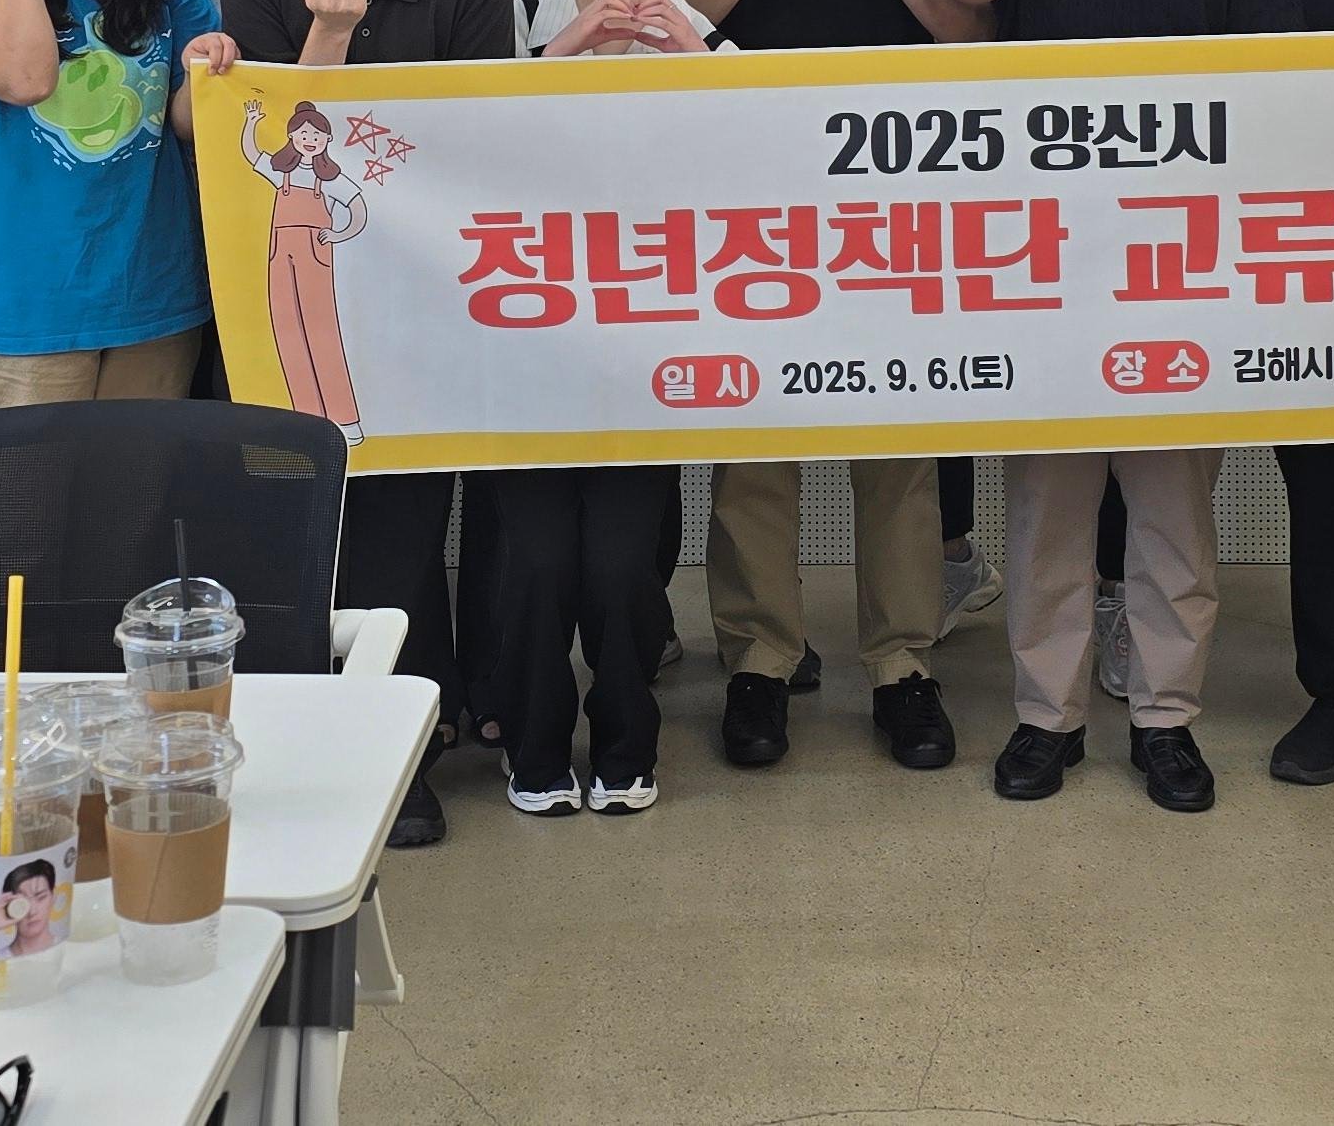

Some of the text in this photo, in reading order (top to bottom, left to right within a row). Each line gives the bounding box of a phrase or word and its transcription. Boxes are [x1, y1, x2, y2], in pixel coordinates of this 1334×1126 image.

[824, 100, 1227, 176] 2025 양산시
[456, 196, 1069, 330] 청년정책단
[1232, 346, 1334, 384] 김해시
